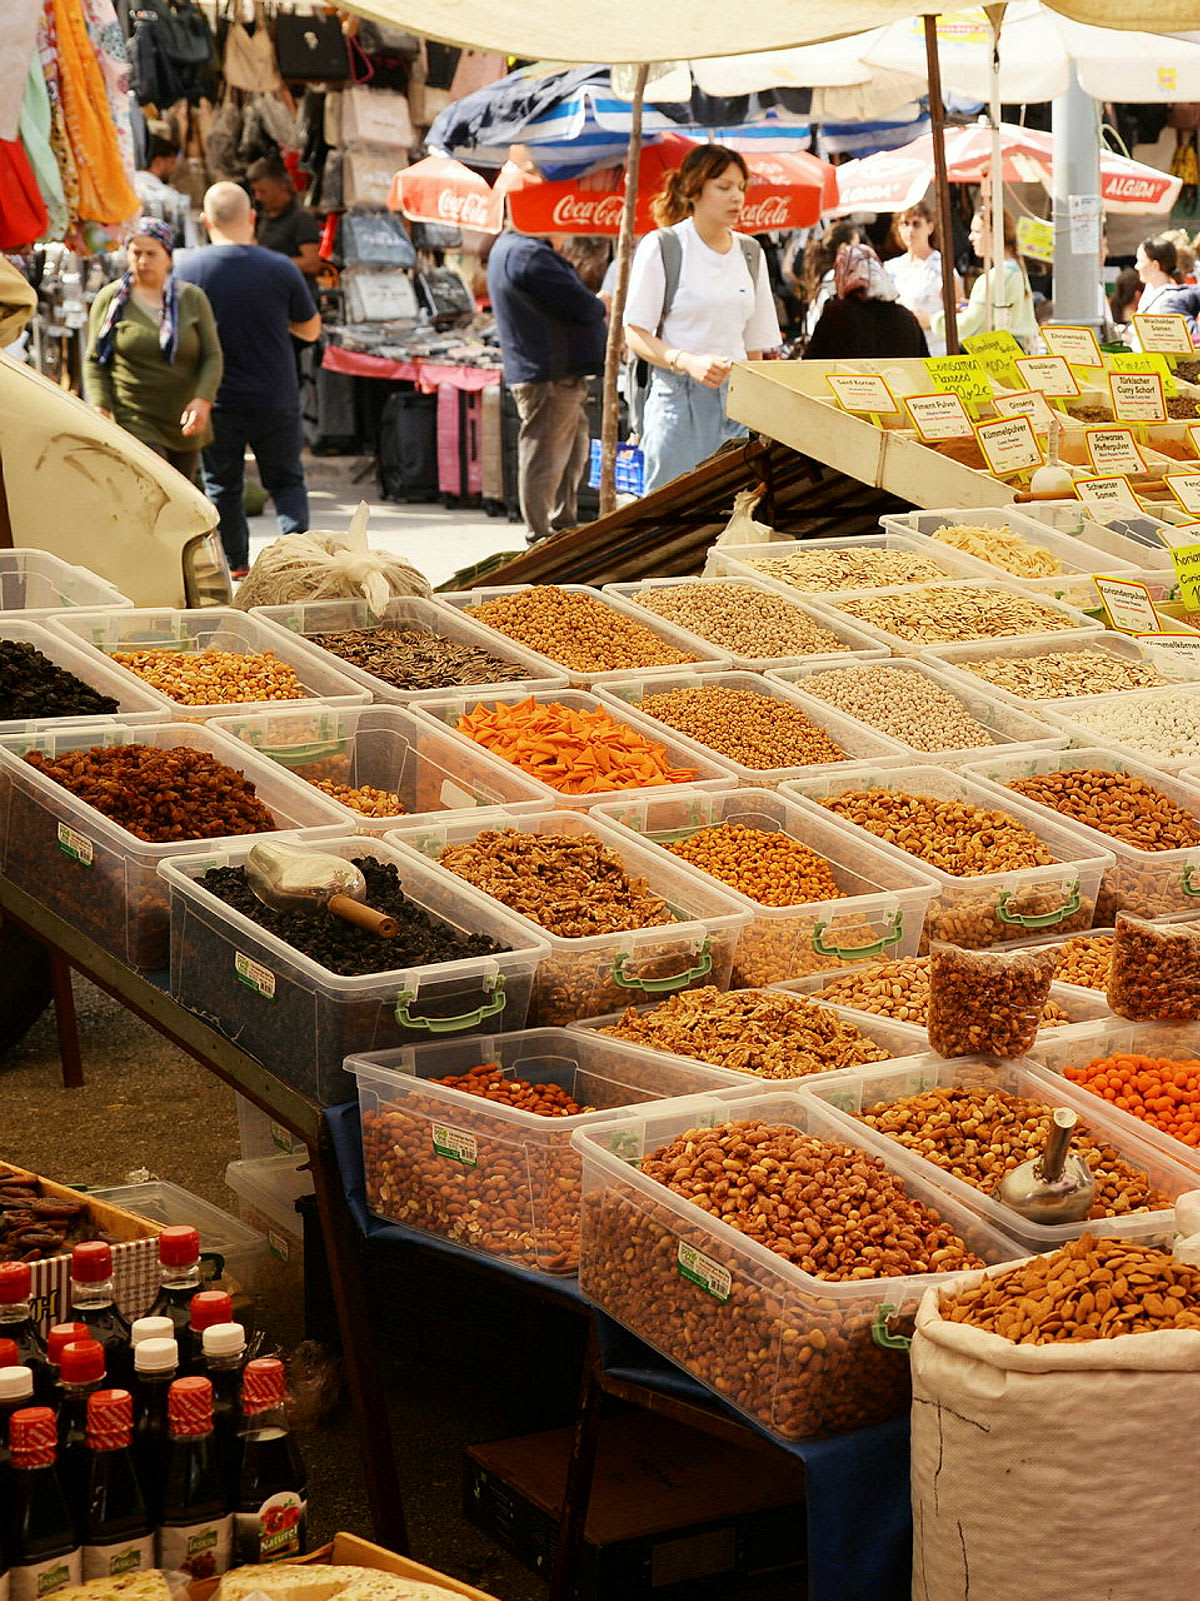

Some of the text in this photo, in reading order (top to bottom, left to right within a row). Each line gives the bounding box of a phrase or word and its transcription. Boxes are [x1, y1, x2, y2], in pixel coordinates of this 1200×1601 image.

[1105, 178, 1155, 198] ALGIDA
[733, 195, 790, 225] oca-Cola
[1117, 386, 1134, 394] Curry
[912, 400, 956, 410] Piment Pulver
[983, 424, 1027, 440] Kümmelpulver
